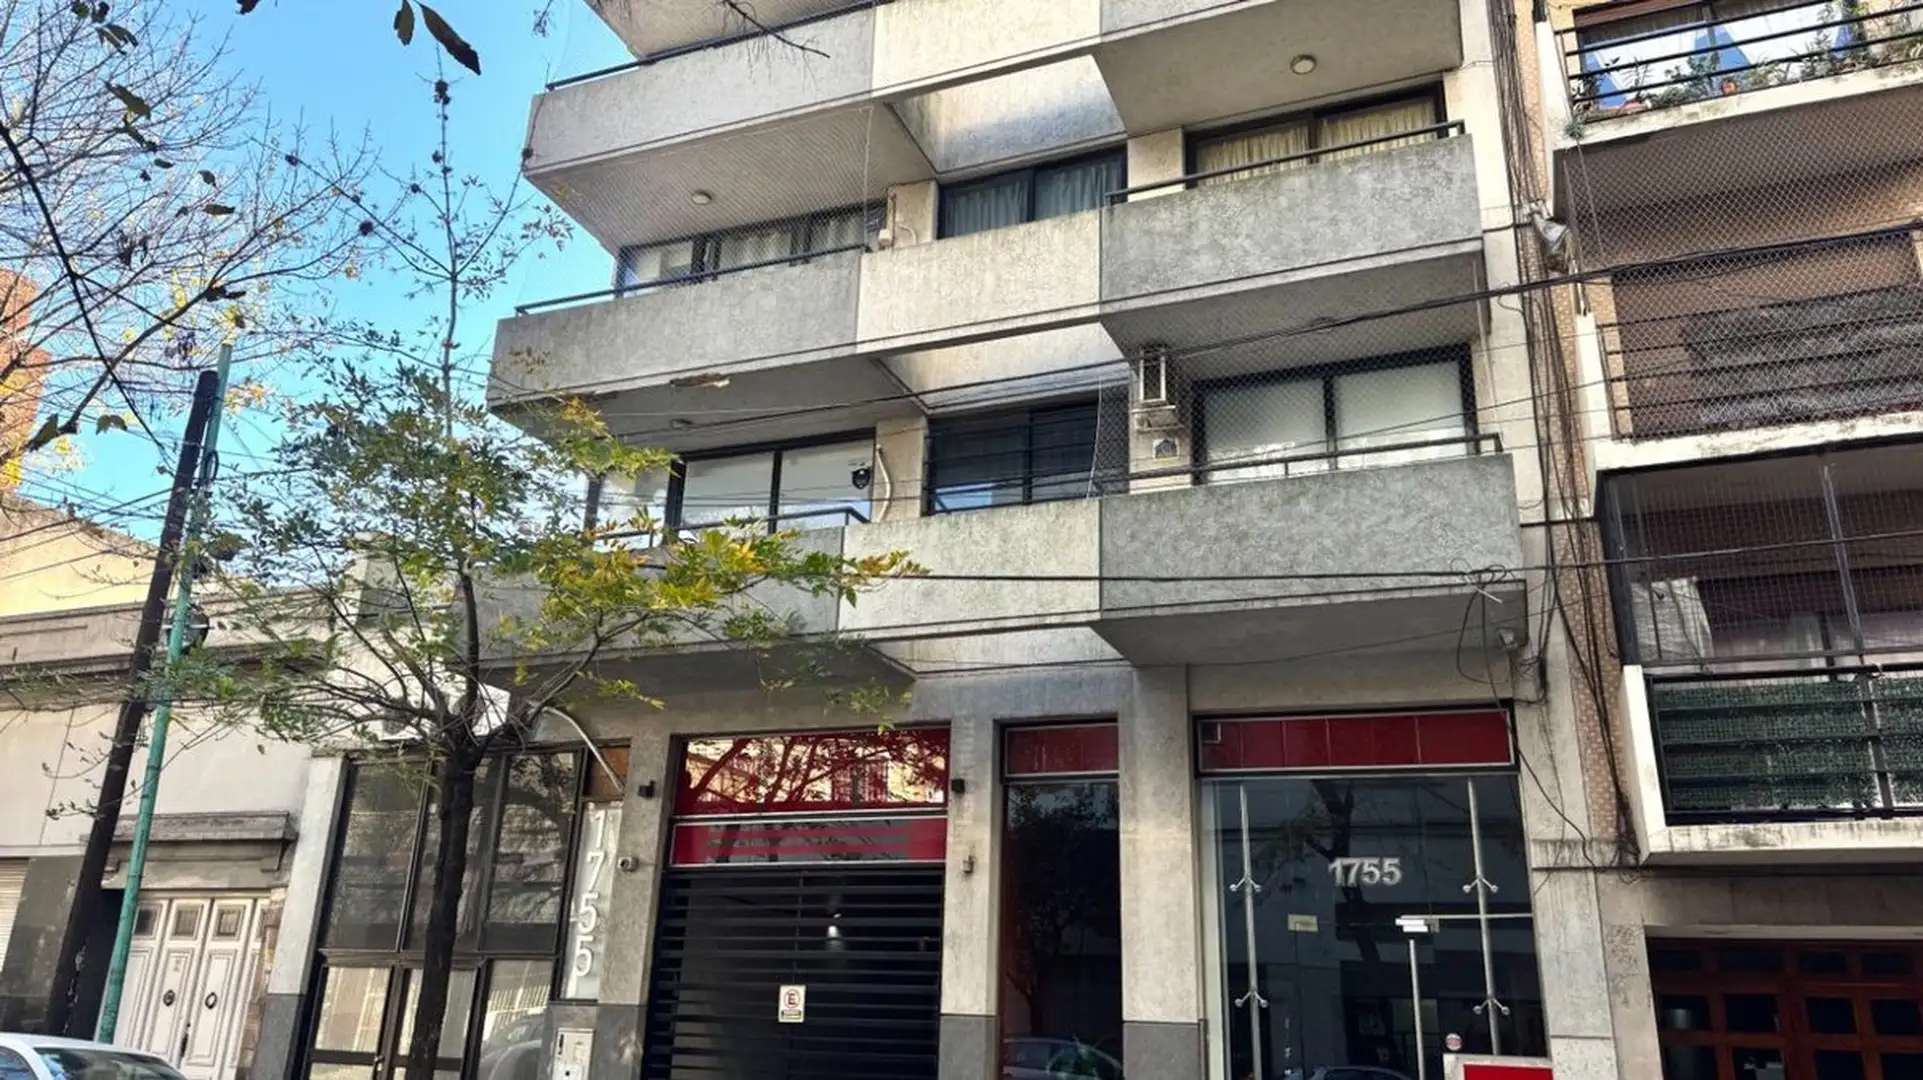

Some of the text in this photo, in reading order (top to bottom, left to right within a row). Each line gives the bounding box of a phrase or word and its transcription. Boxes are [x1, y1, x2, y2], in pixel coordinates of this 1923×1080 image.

[1328, 857, 1402, 887] 1755
[575, 809, 606, 977] 1755
[787, 992, 798, 1006] E
